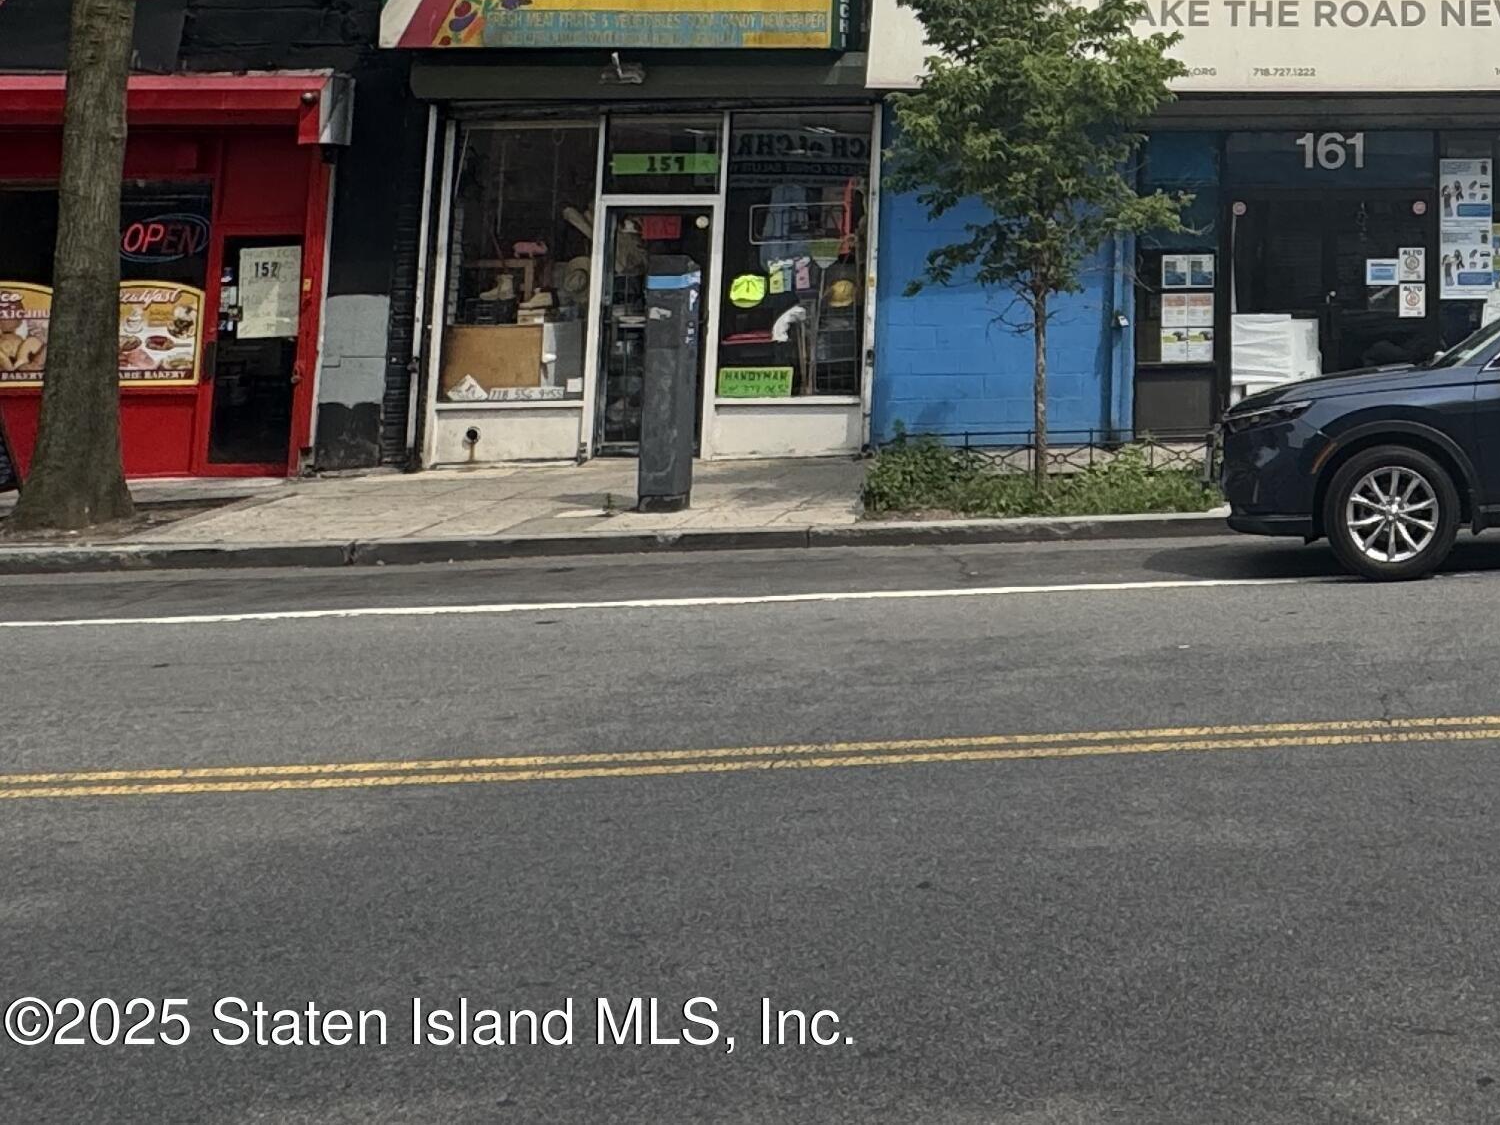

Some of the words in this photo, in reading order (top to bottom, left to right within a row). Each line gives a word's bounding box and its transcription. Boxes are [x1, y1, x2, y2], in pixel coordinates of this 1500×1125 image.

[1131, 0, 1210, 27] AKE
[1223, 0, 1300, 27] THE
[1314, 0, 1426, 28] ROAD
[1295, 131, 1365, 171] 161
[123, 223, 200, 255] OPEN
